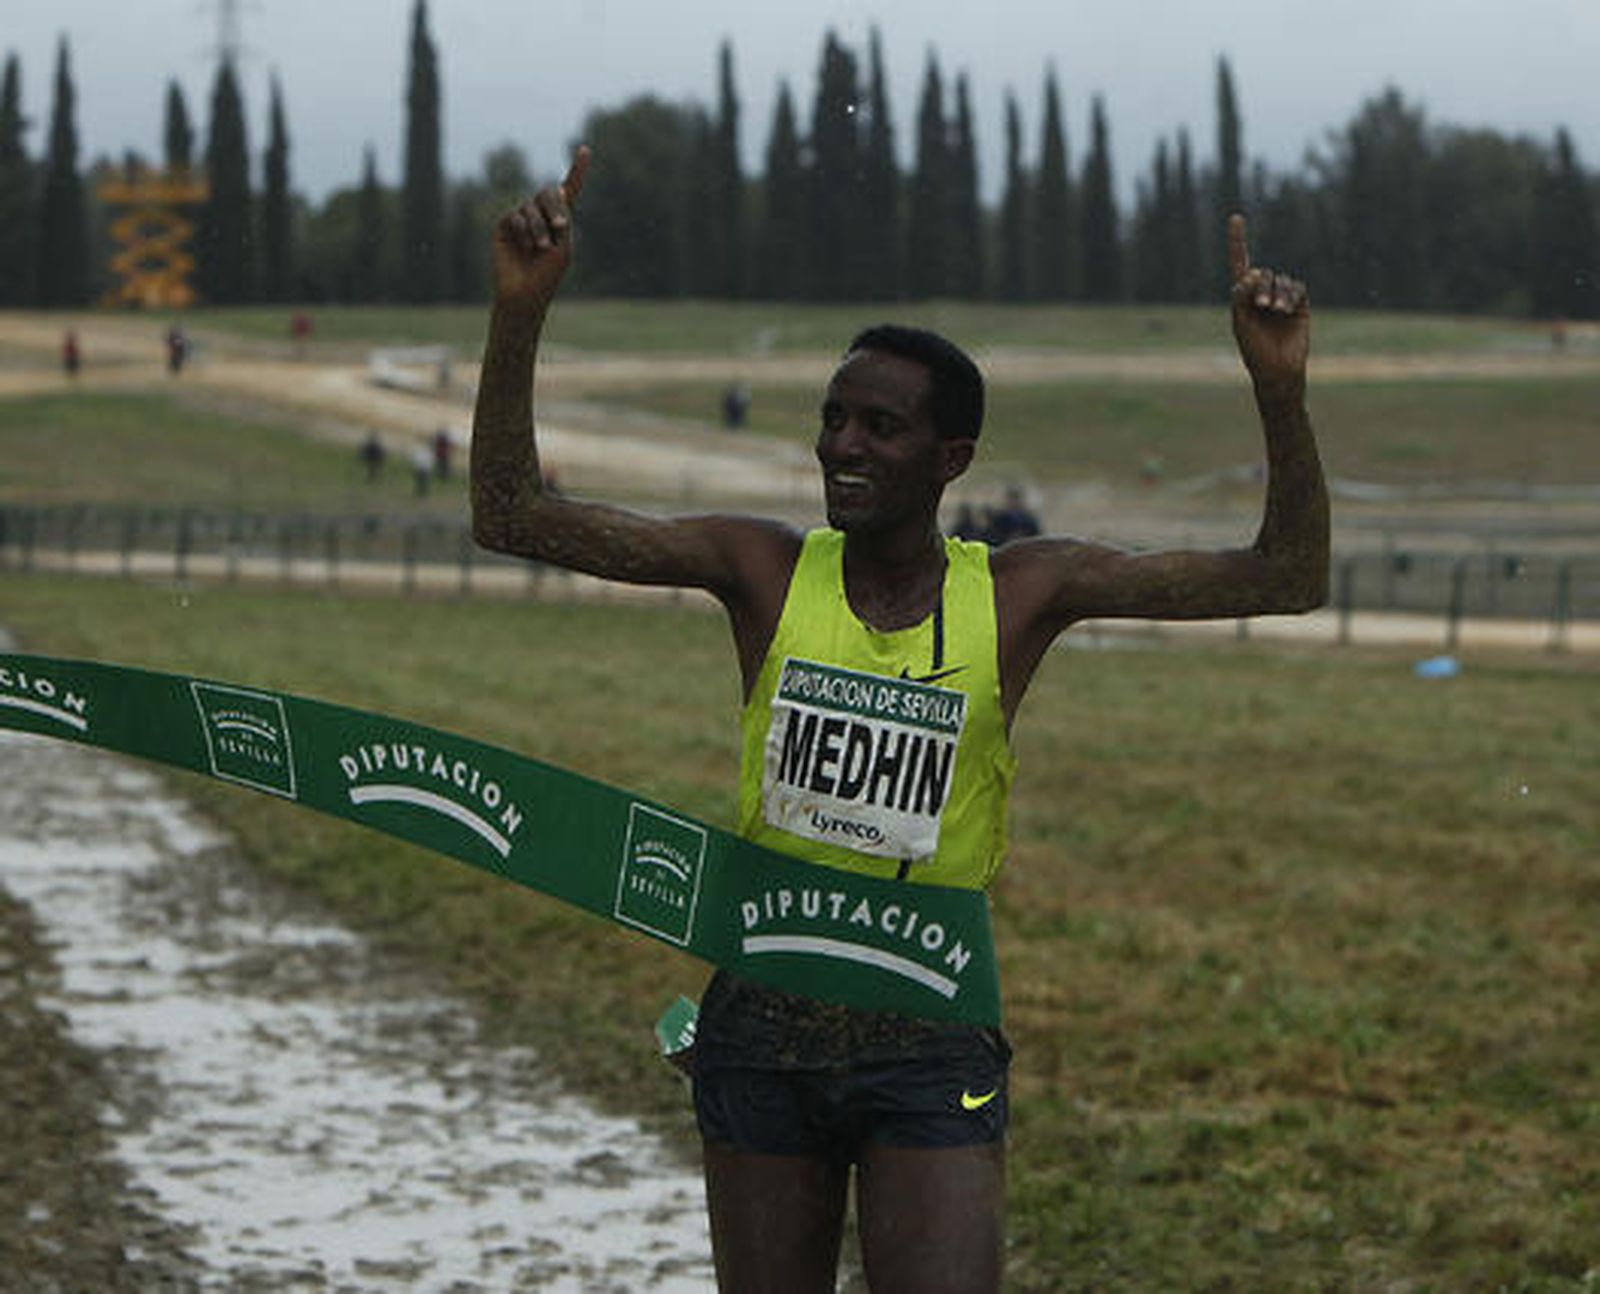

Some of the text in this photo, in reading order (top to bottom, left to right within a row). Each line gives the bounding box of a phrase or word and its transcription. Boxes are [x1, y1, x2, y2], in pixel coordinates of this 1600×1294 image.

[874, 686, 900, 715] DE
[900, 691, 961, 727] SEVILLA
[339, 743, 524, 836] DIPUTACION
[778, 708, 954, 818] MEDHIN
[811, 810, 880, 841] Lyreco
[741, 888, 972, 975] DIPUTACION
